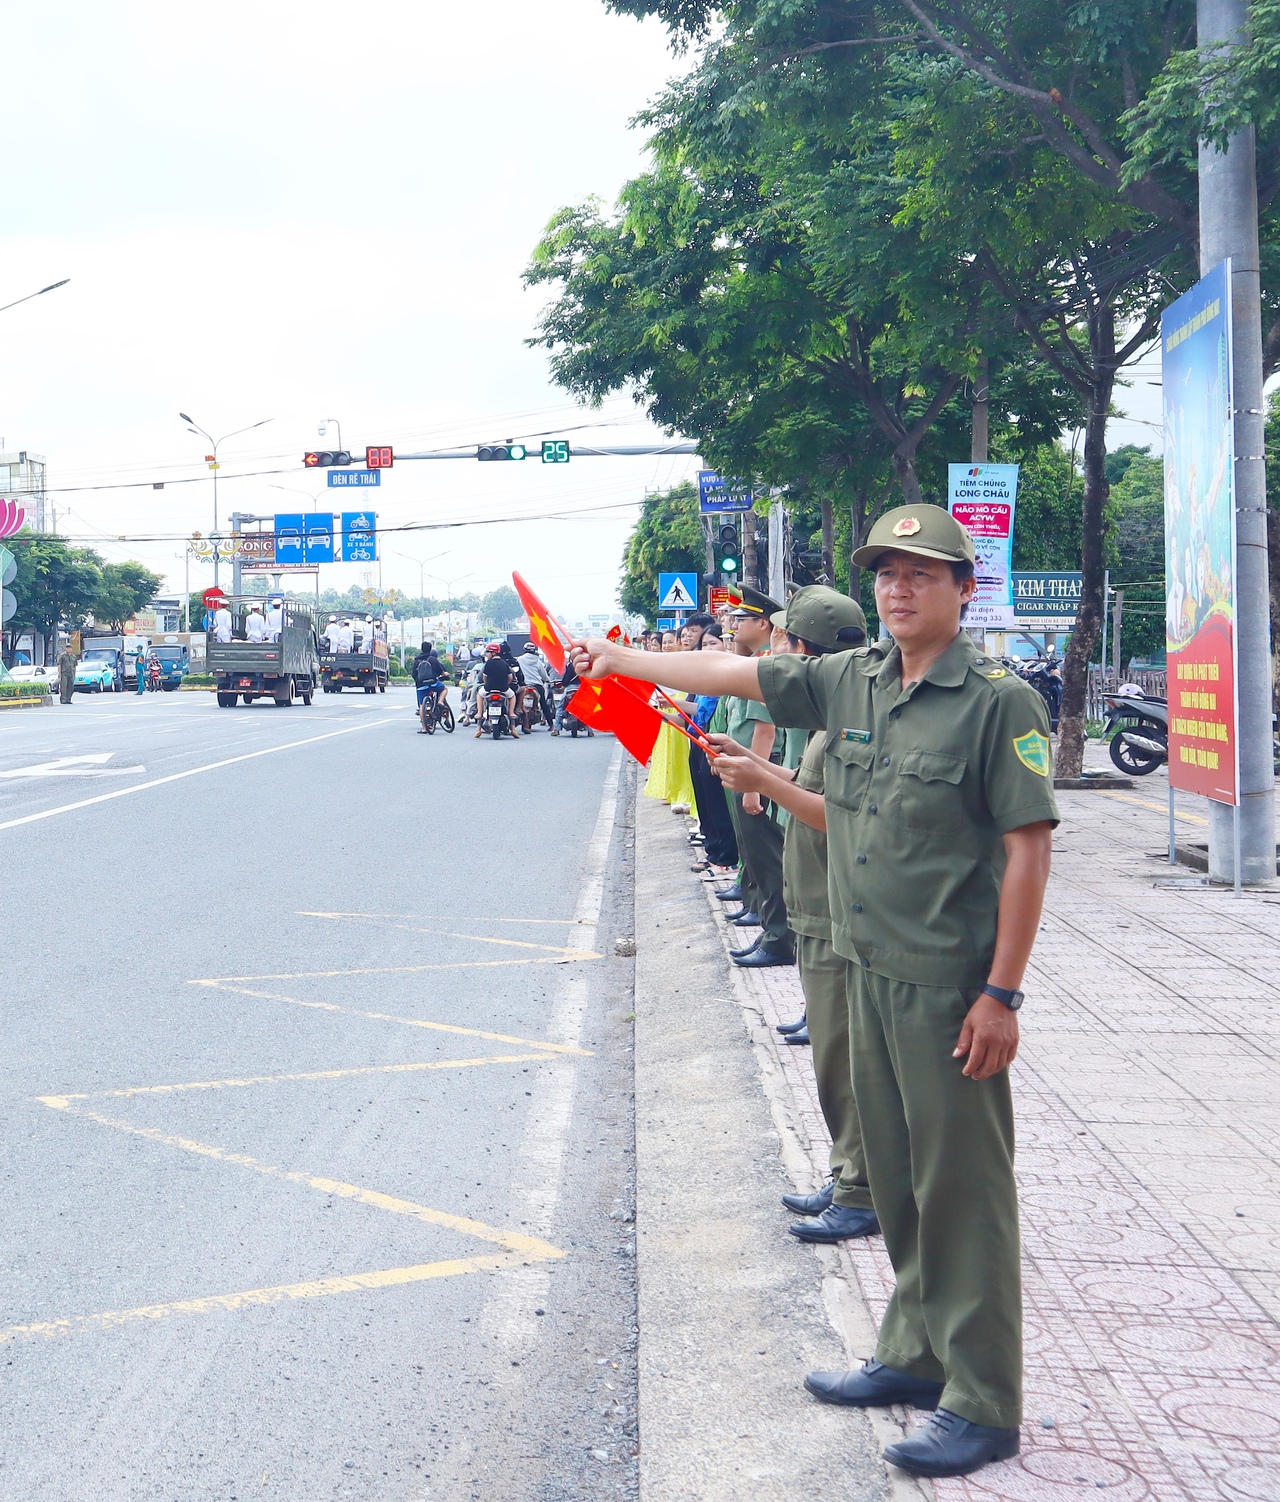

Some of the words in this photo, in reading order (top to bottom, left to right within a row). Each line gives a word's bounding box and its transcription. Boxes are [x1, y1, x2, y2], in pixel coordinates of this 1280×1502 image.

[368, 448, 392, 467] 68
[543, 442, 568, 462] 25
[332, 472, 347, 485] ĐÈN
[349, 472, 358, 484] RẼ
[360, 471, 376, 484] TRÁI
[960, 479, 977, 487] TIÊM
[955, 489, 981, 498] LONG
[982, 488, 1010, 499] CHÂU
[955, 505, 975, 513] NÃO
[976, 505, 990, 513] MÔ
[1017, 579, 1045, 597] KIM
[1016, 602, 1044, 611] CIGAR
[1046, 600, 1071, 612] NHẬP
